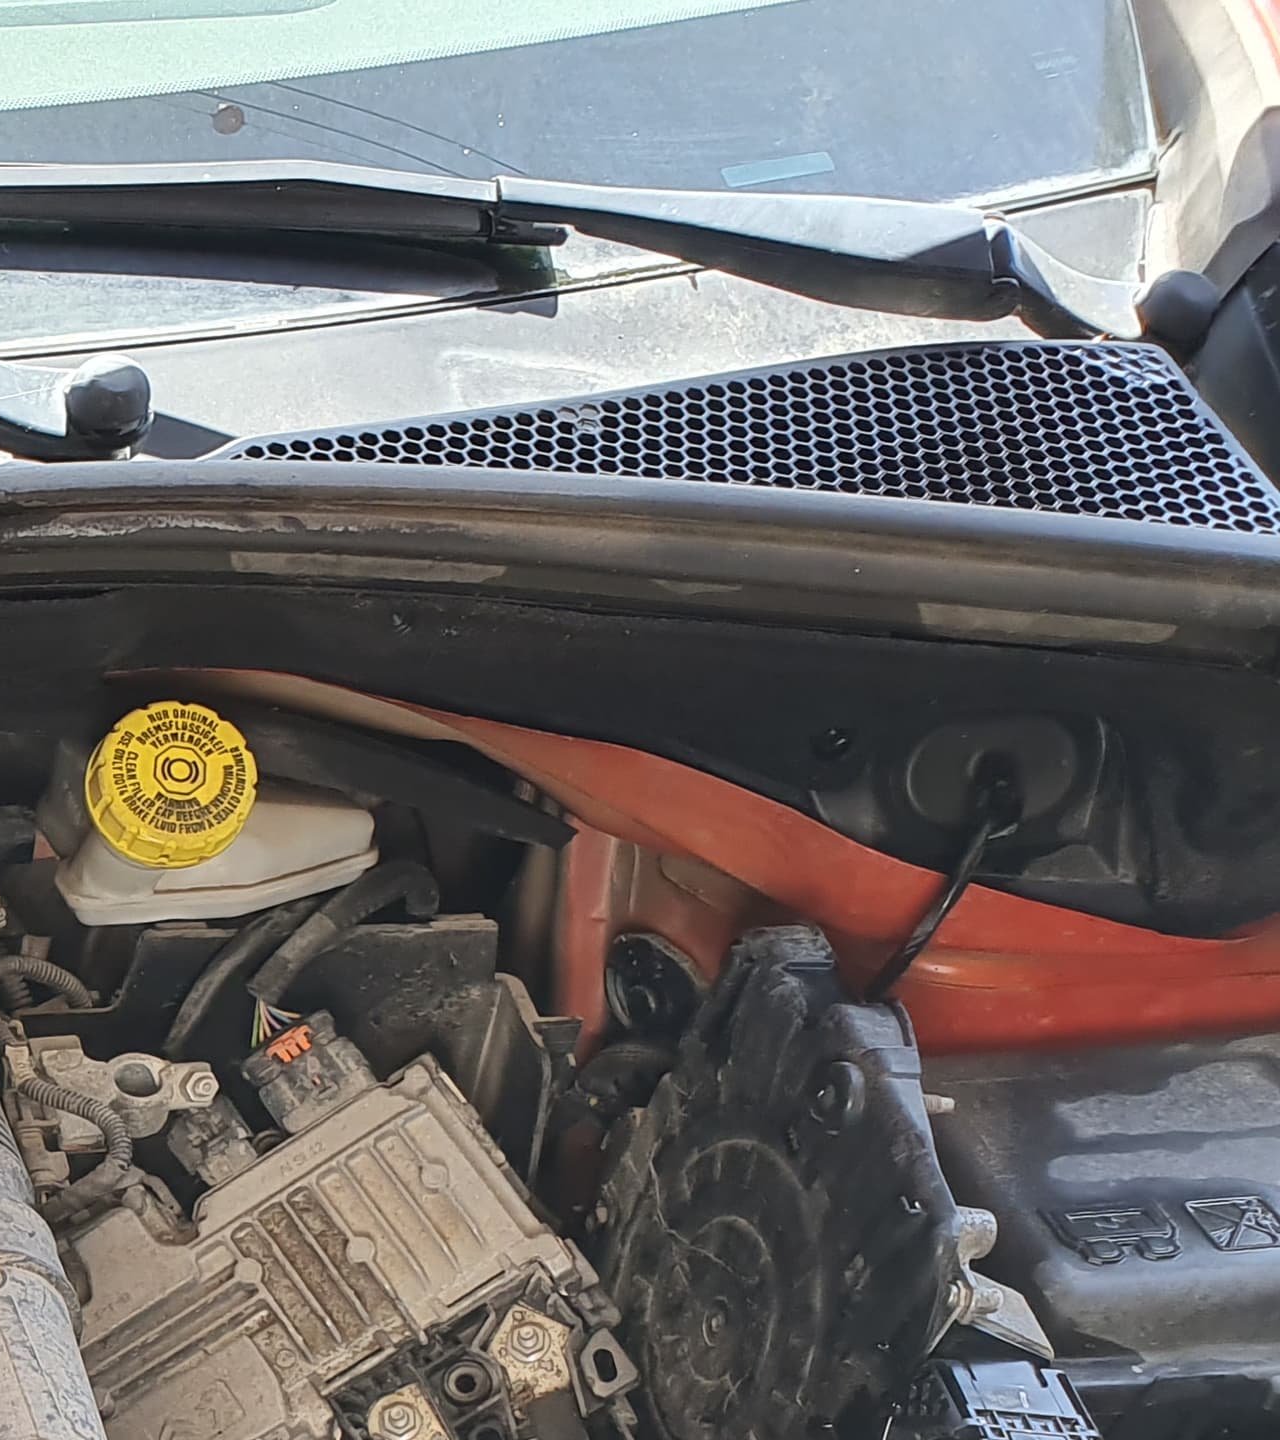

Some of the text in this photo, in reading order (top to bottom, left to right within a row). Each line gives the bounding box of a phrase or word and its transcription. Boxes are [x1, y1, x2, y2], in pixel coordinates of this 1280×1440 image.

[150, 732, 214, 758] VERWENDEN
[173, 709, 219, 733] ORIGINAL
[112, 748, 126, 770] ONLY
[122, 796, 150, 822] BRAKE
[148, 818, 177, 834] FLUID
[178, 821, 207, 834] FROM
[213, 795, 241, 825] SEALED
[230, 746, 247, 796] CONTAINER
[125, 751, 139, 780] CLEAN
[155, 806, 177, 820] CAP
[176, 804, 213, 821] BEFORE
